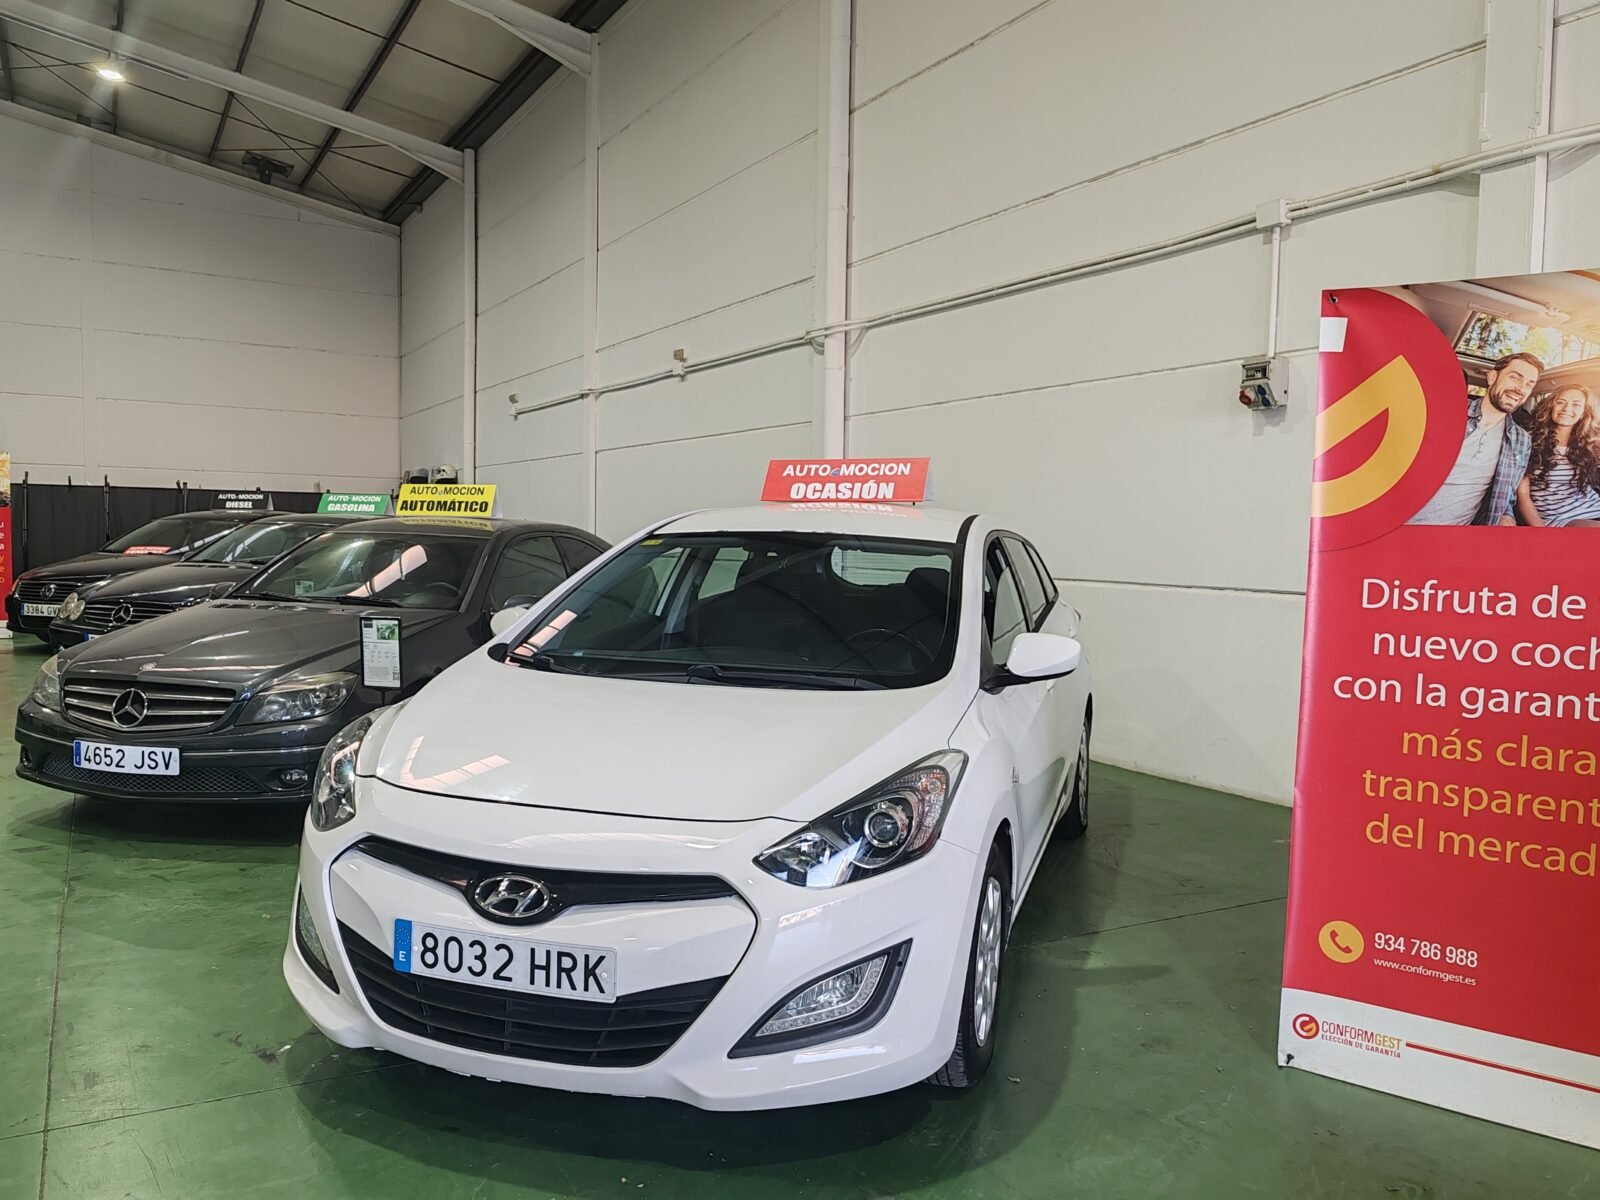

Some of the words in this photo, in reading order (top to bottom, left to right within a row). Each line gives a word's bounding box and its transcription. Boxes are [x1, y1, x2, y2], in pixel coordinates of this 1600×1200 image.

[351, 495, 382, 503] MOCION
[790, 480, 895, 499] OCASIÓN
[225, 501, 253, 509] DIESEL
[327, 503, 376, 512] GASOLINA
[399, 499, 489, 513] AUTOMÁTICO
[25, 605, 45, 614] 3384
[46, 606, 61, 615] GV
[1361, 578, 1517, 617] Disfruta
[1531, 584, 1587, 620] de
[1372, 632, 1499, 664] nuevo
[1333, 675, 1402, 703] con
[1415, 672, 1447, 707] la
[84, 745, 125, 769] 4652
[134, 750, 172, 771] JSV
[1402, 728, 1484, 763] más
[1495, 734, 1597, 776] clara
[1364, 813, 1424, 850] del
[398, 951, 406, 962] E
[420, 932, 514, 983] 8032
[529, 946, 607, 994] HRK
[1374, 932, 1406, 953] 934
[1410, 938, 1442, 961] 786
[1445, 946, 1478, 968] 988
[1373, 957, 1477, 986] www.conformgest.es
[1321, 1020, 1402, 1051] CONFORMGEST
[1321, 1033, 1353, 1047] ELECCIÓN
[1354, 1041, 1364, 1050] DE
[1365, 1044, 1401, 1059] GARANTÍA
